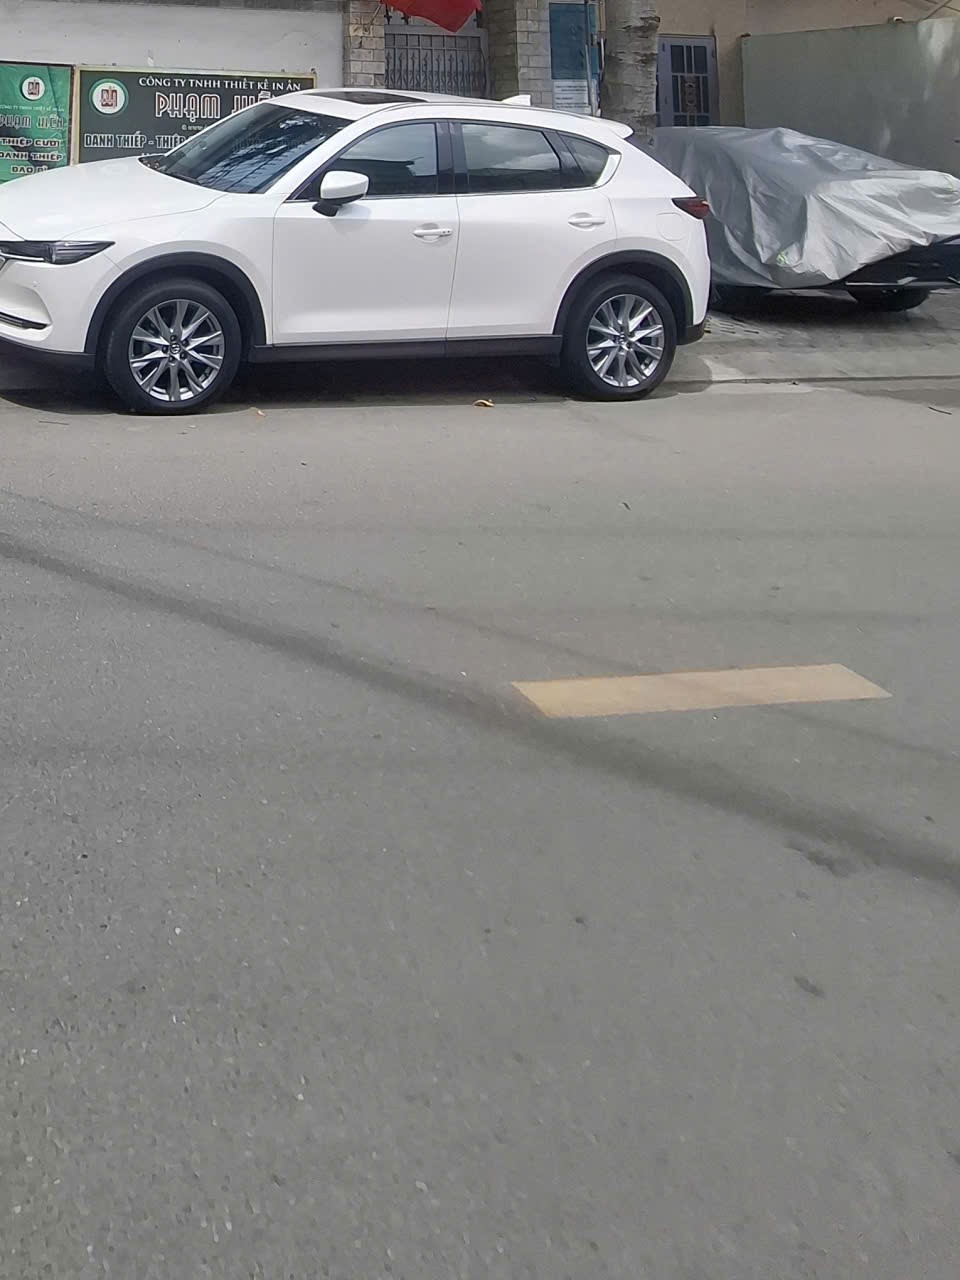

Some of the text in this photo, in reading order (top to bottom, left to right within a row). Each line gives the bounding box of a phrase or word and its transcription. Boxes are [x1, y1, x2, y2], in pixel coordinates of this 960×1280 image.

[139, 75, 171, 87] CÔNG
[173, 78, 188, 87] TY
[189, 79, 220, 88] TNHH
[272, 82, 284, 90] IN
[155, 92, 221, 123] PHẠM
[84, 133, 114, 147] DANH
[115, 131, 147, 148] THIẾP
[31, 151, 63, 161] THIẾP
